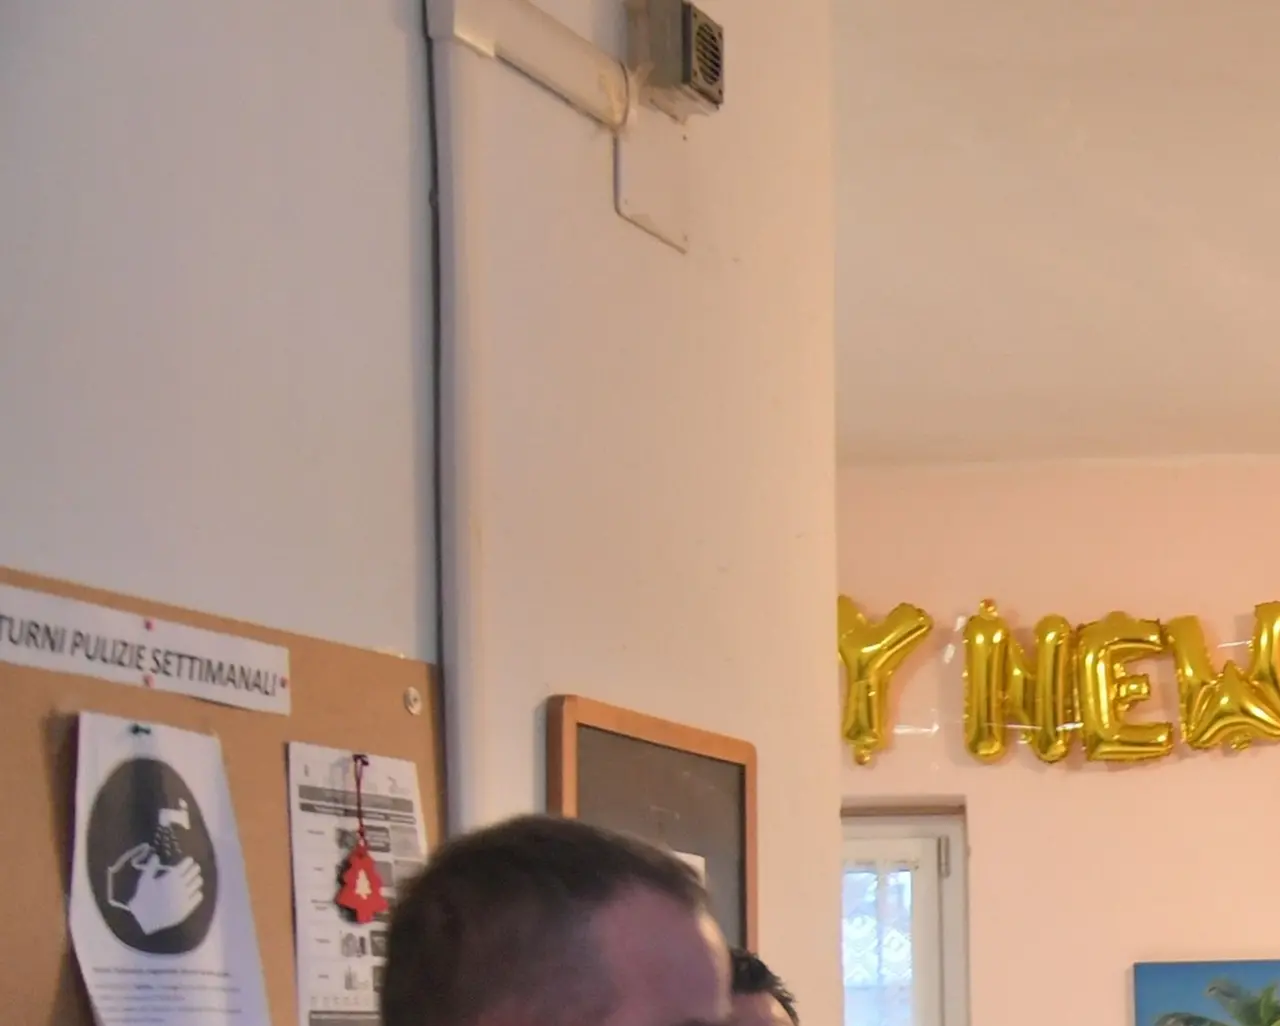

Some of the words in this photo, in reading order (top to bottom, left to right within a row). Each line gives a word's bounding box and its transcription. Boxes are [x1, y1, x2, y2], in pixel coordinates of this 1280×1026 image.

[0, 613, 66, 654] TURNI
[70, 629, 146, 672] PULIZIE
[150, 647, 278, 697] SETTIMANALI
